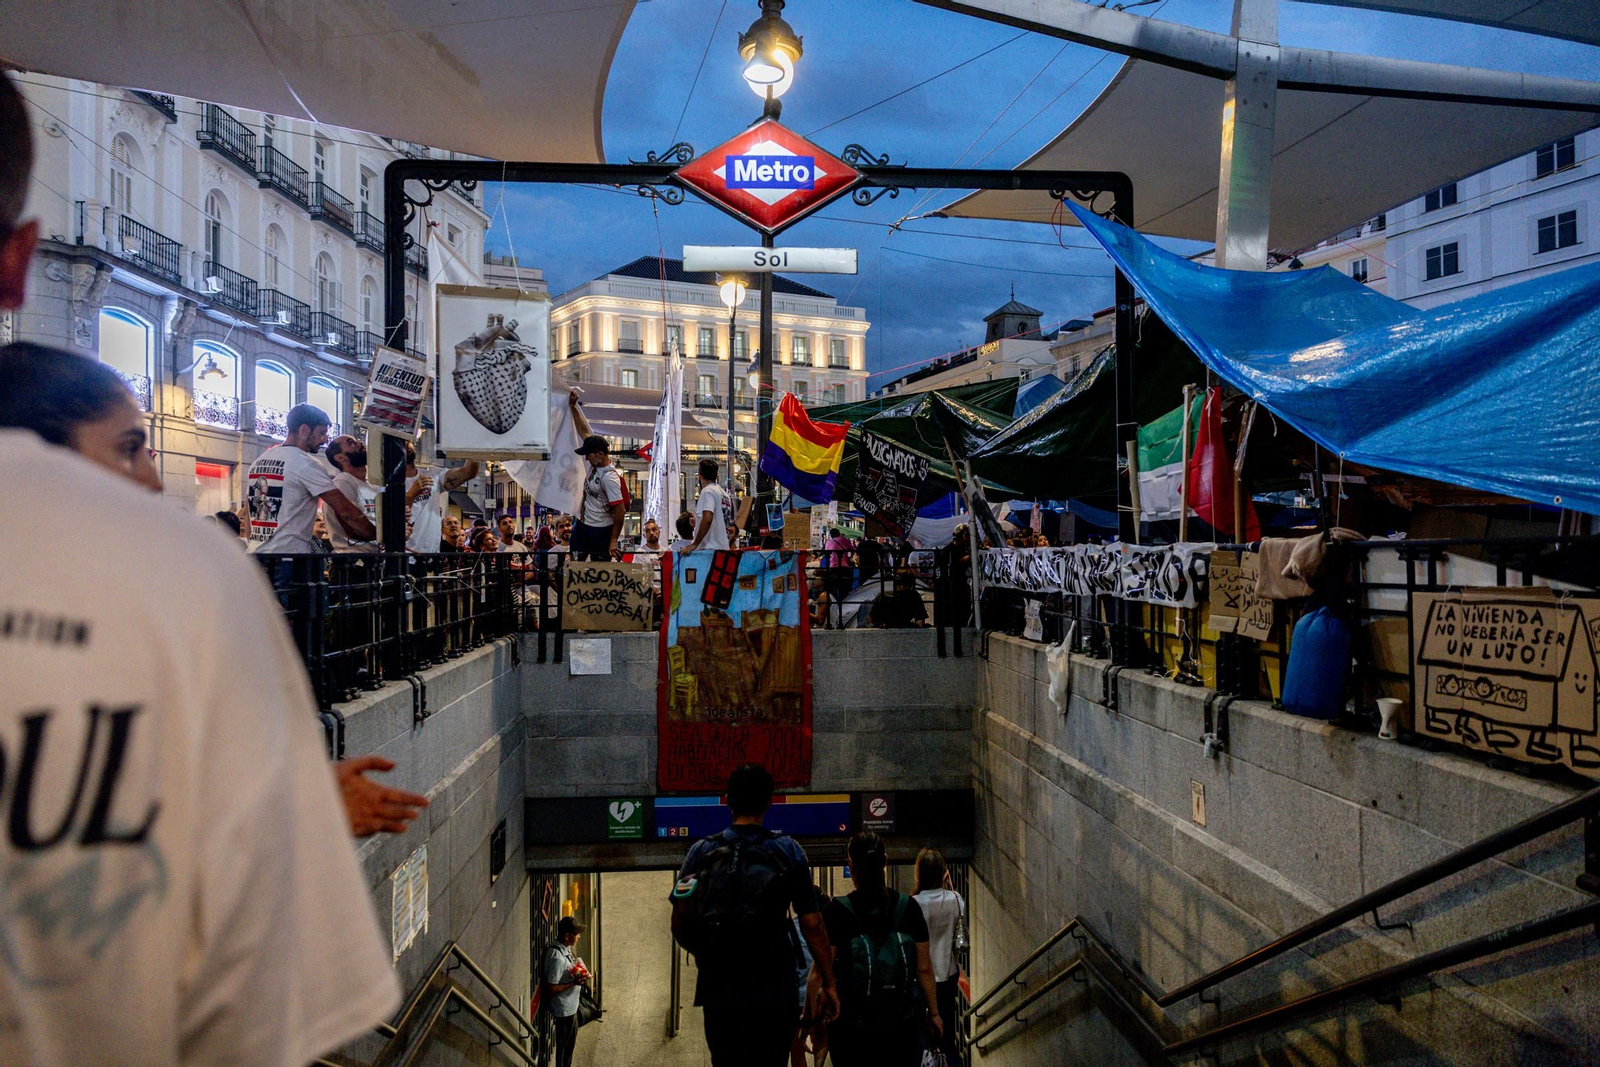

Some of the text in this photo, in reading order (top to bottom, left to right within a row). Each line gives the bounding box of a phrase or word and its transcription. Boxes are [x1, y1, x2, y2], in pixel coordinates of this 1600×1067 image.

[734, 160, 810, 182] Metro
[753, 251, 788, 267] Sol
[375, 374, 422, 395] TRABAJADORA
[377, 364, 425, 386] JUVENTUD
[613, 569, 653, 603] PAYASA
[581, 602, 651, 630] TU CASA!
[1436, 605, 1456, 622] LA
[1435, 623, 1455, 636] NO
[1531, 628, 1565, 647] SER
[1447, 640, 1549, 667] UN LUJO!
[706, 705, 764, 720] idealista
[0, 703, 161, 852] UL
